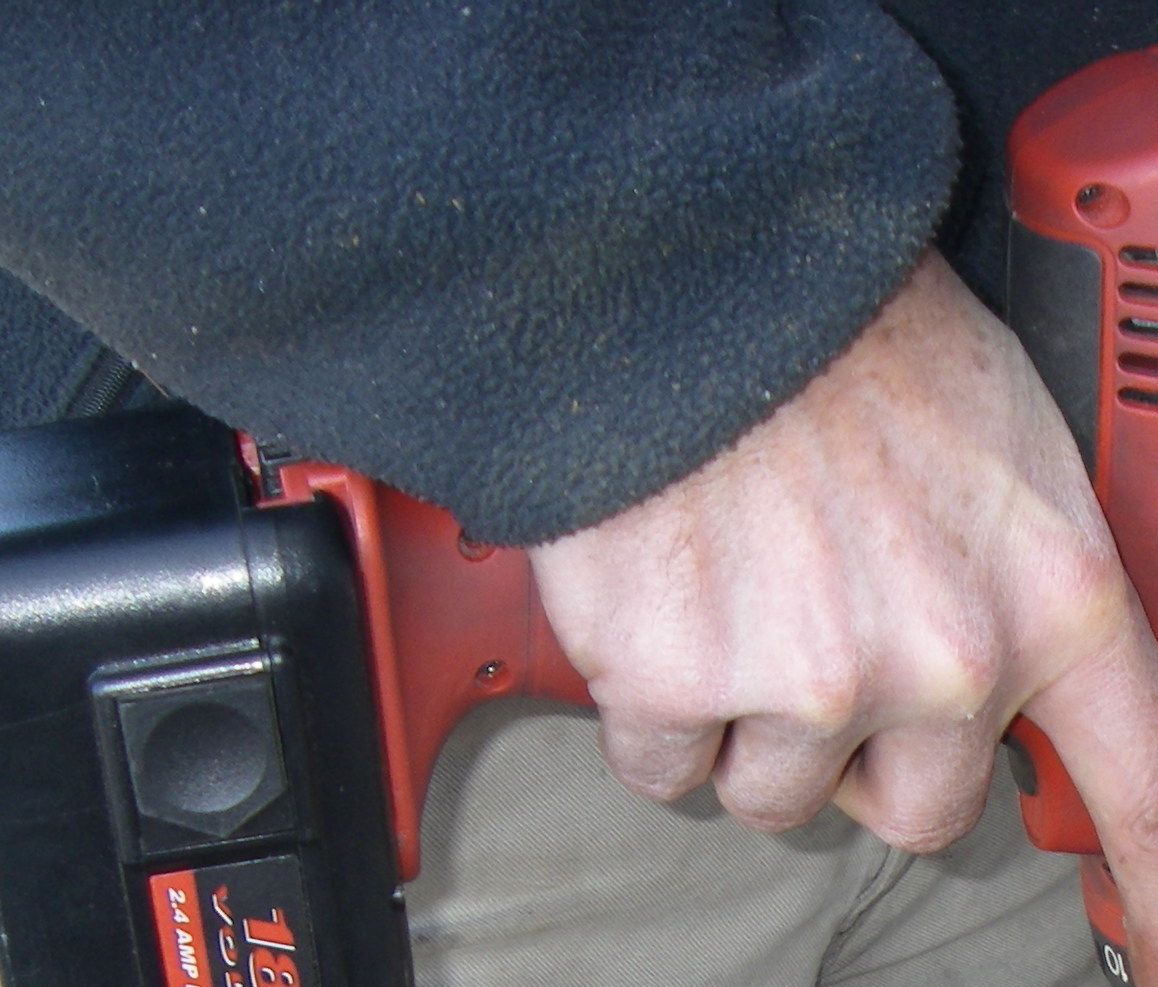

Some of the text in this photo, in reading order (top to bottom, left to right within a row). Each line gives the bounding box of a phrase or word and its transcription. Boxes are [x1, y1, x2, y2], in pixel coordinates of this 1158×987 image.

[168, 887, 190, 924] 2.4
[175, 928, 199, 980] AMP
[1103, 944, 1128, 984] 10
